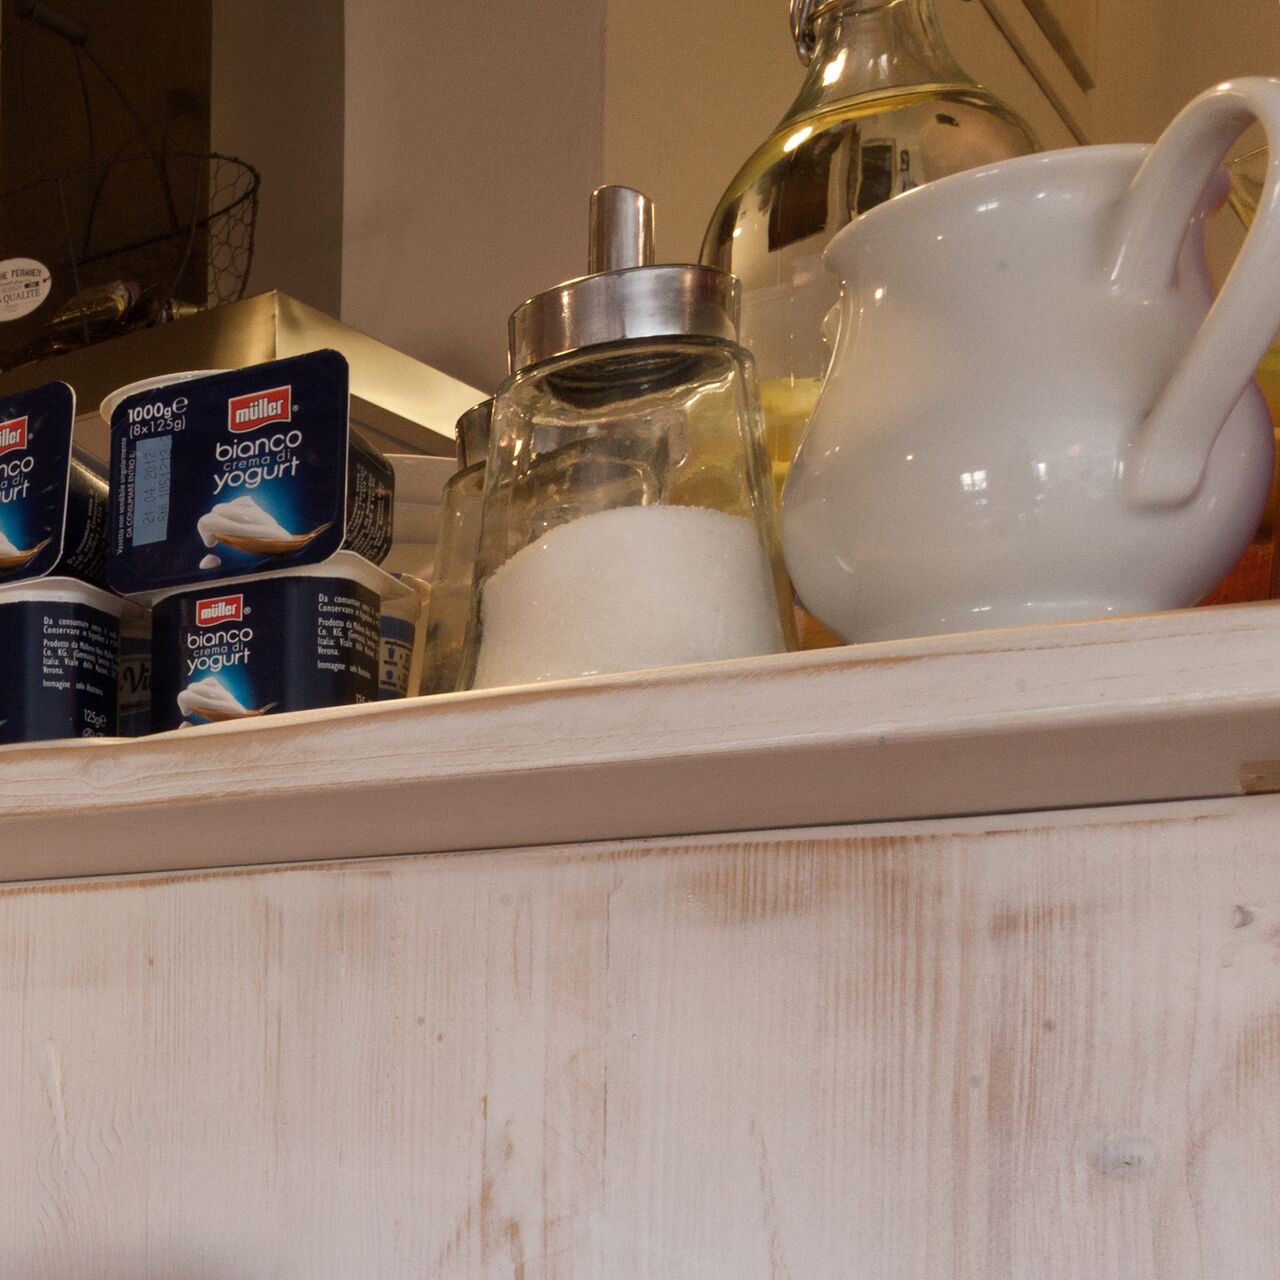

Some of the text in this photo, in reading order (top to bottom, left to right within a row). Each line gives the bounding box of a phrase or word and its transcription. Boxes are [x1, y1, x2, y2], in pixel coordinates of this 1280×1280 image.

[234, 398, 285, 424] müller
[215, 430, 303, 462] bianco
[223, 447, 291, 472] crema di
[12, 473, 25, 486] di
[213, 458, 301, 495] yogurt
[318, 593, 328, 603] Da
[200, 602, 238, 619] müller
[318, 603, 354, 615] Conservare
[43, 616, 53, 625] Da
[318, 617, 344, 628] Prodotto
[43, 625, 80, 636] Conservare
[43, 638, 69, 648] Prodotto
[187, 627, 254, 650] bianco
[193, 641, 244, 658] crema di
[186, 647, 251, 676] yogurt
[317, 659, 346, 672] Immagine
[43, 666, 64, 675] Verona.
[43, 679, 70, 691] Immagine
